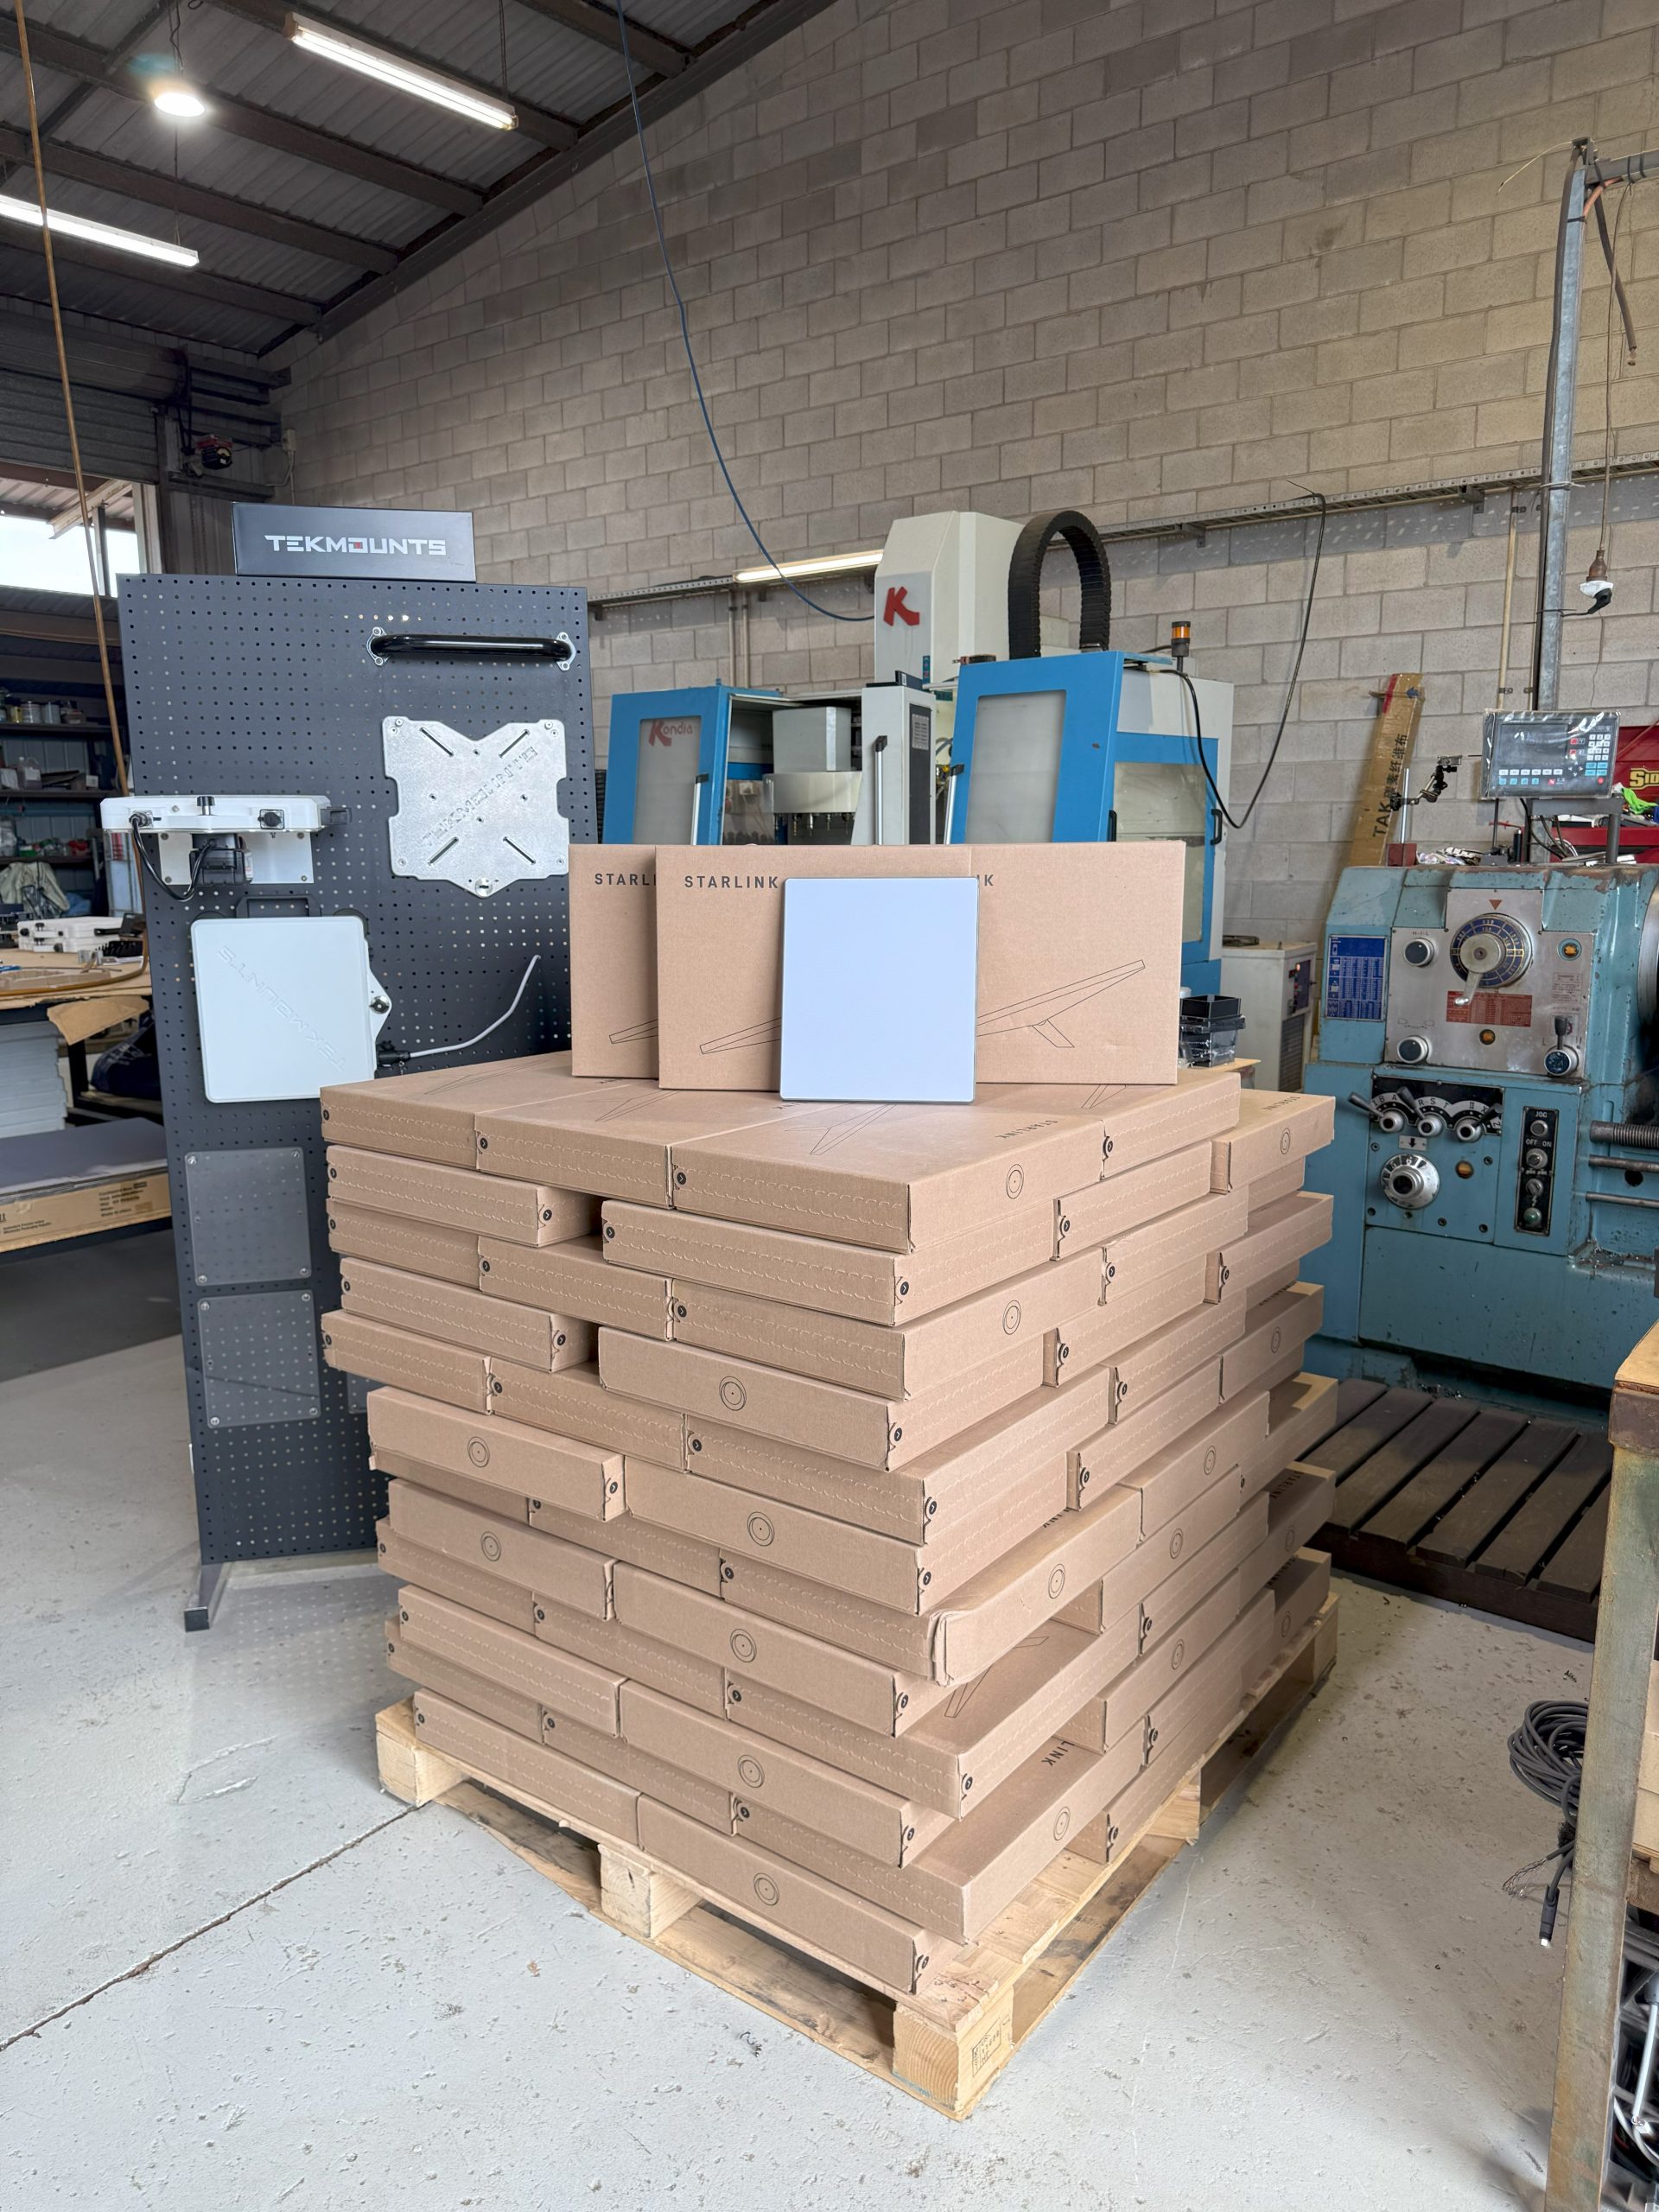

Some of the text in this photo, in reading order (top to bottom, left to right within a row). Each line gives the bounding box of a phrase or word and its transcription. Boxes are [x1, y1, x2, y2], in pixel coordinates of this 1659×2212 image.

[264, 534, 447, 556] TEKMOUNTS
[649, 719, 693, 747] Kondia
[684, 875, 779, 888] STARLINK
